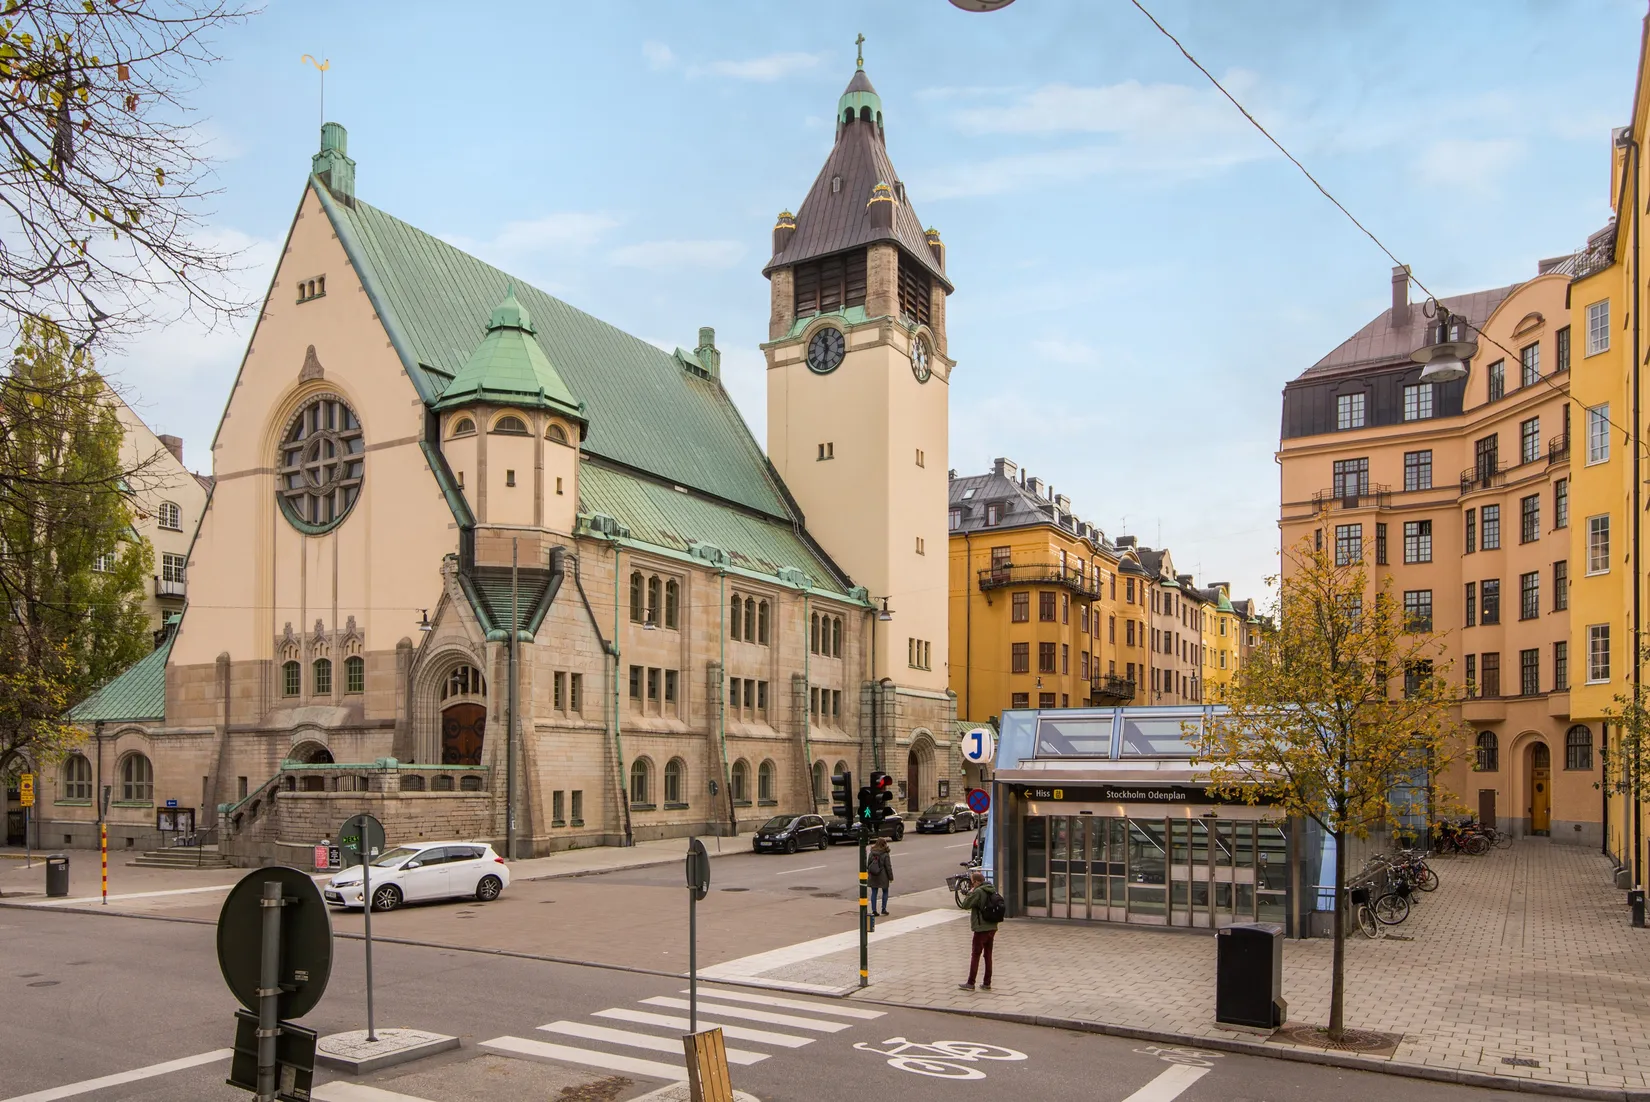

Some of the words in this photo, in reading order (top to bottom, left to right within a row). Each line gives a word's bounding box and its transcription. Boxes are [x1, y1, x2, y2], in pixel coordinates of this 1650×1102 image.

[969, 733, 982, 759] J
[1036, 789, 1050, 797] Hiss
[1106, 790, 1146, 799] Stockholm
[1148, 791, 1186, 801] Odenplan
